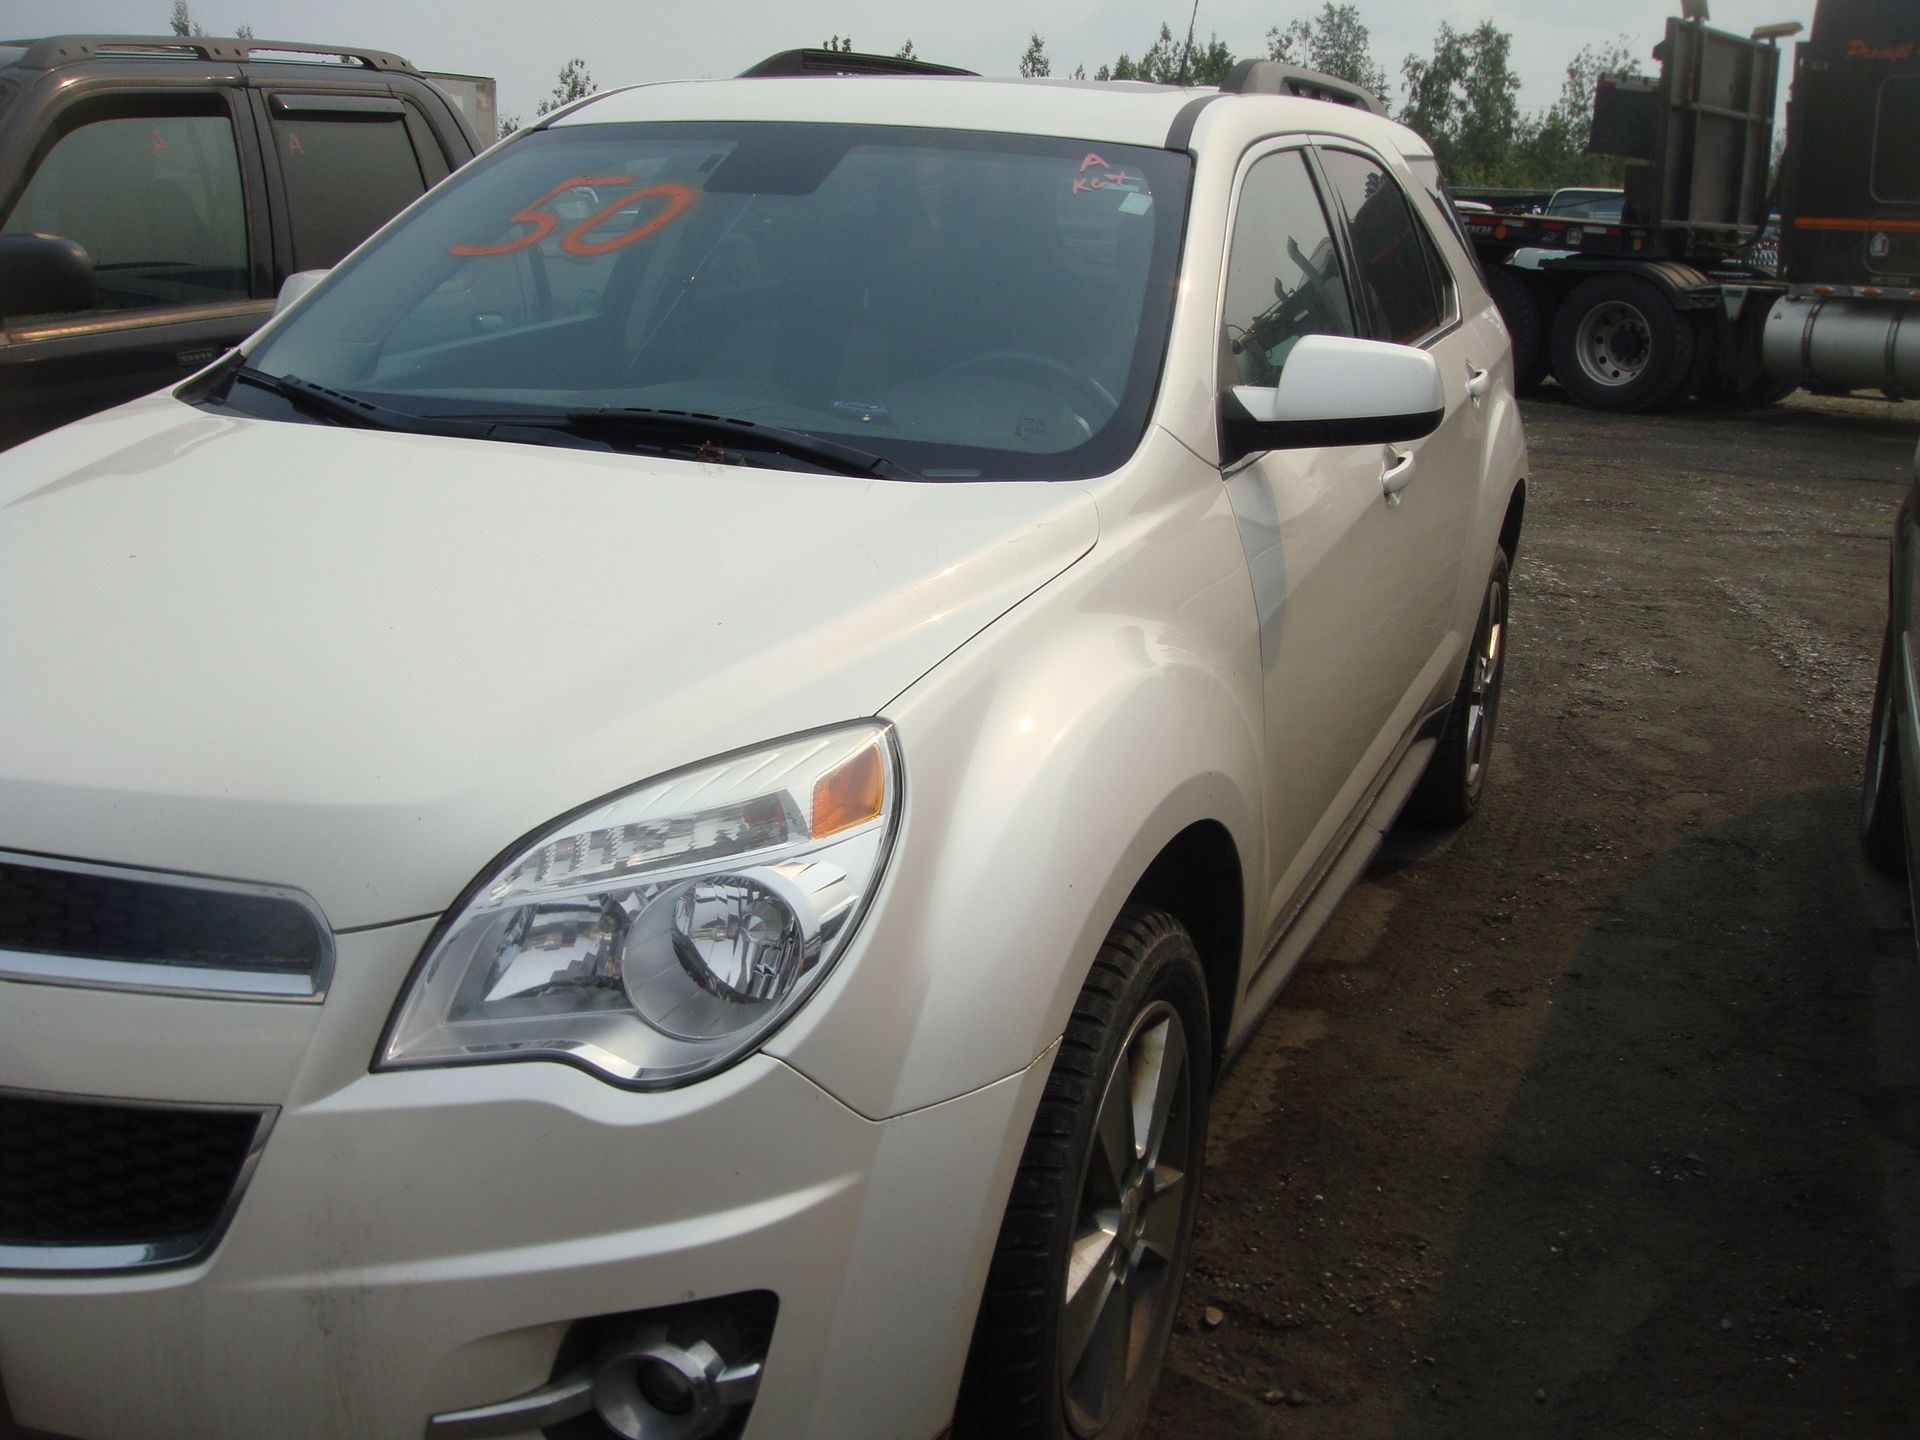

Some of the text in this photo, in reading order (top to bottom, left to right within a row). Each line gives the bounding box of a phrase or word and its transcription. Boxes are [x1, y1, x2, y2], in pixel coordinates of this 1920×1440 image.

[151, 129, 170, 160] A
[288, 131, 304, 156] A
[1079, 152, 1110, 172] A
[448, 174, 696, 255] 50
